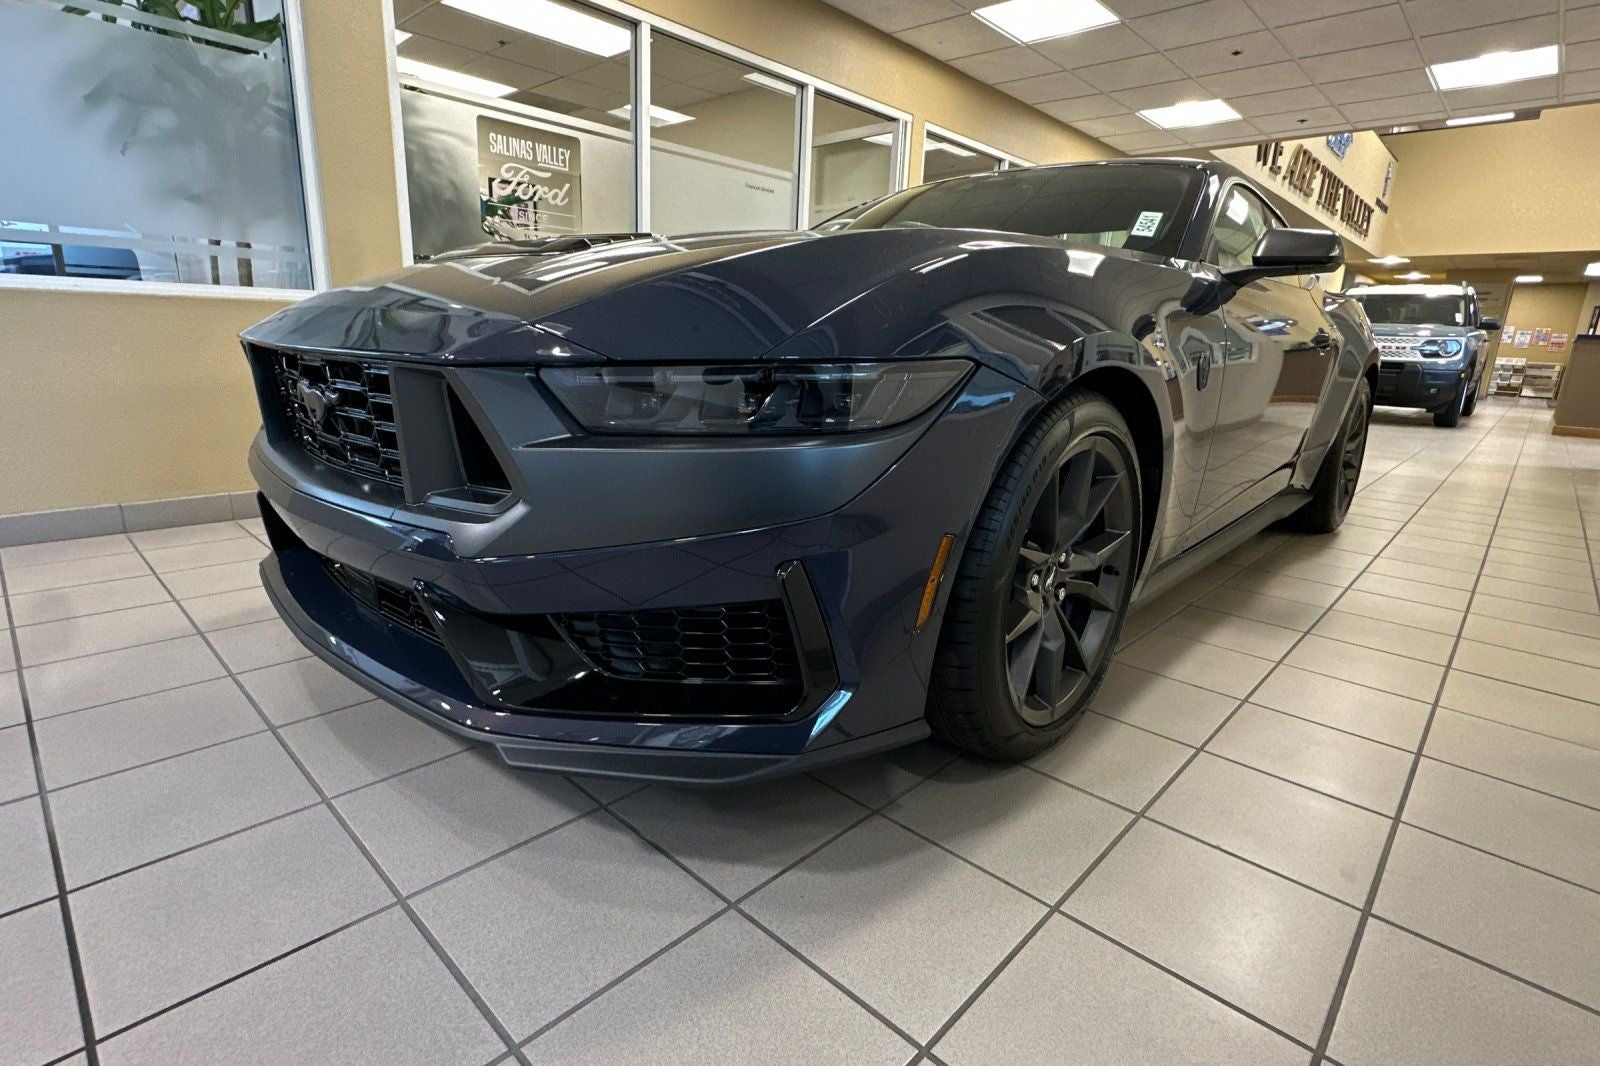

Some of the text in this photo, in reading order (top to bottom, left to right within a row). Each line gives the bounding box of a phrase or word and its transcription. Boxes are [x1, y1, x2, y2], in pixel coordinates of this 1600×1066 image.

[489, 132, 571, 171] SALINAS VALLEY
[492, 162, 571, 206] Ford
[1281, 143, 1322, 198] ARE
[1316, 164, 1345, 217] THE
[1340, 184, 1375, 238] VALLEY
[518, 211, 549, 223] SINCE
